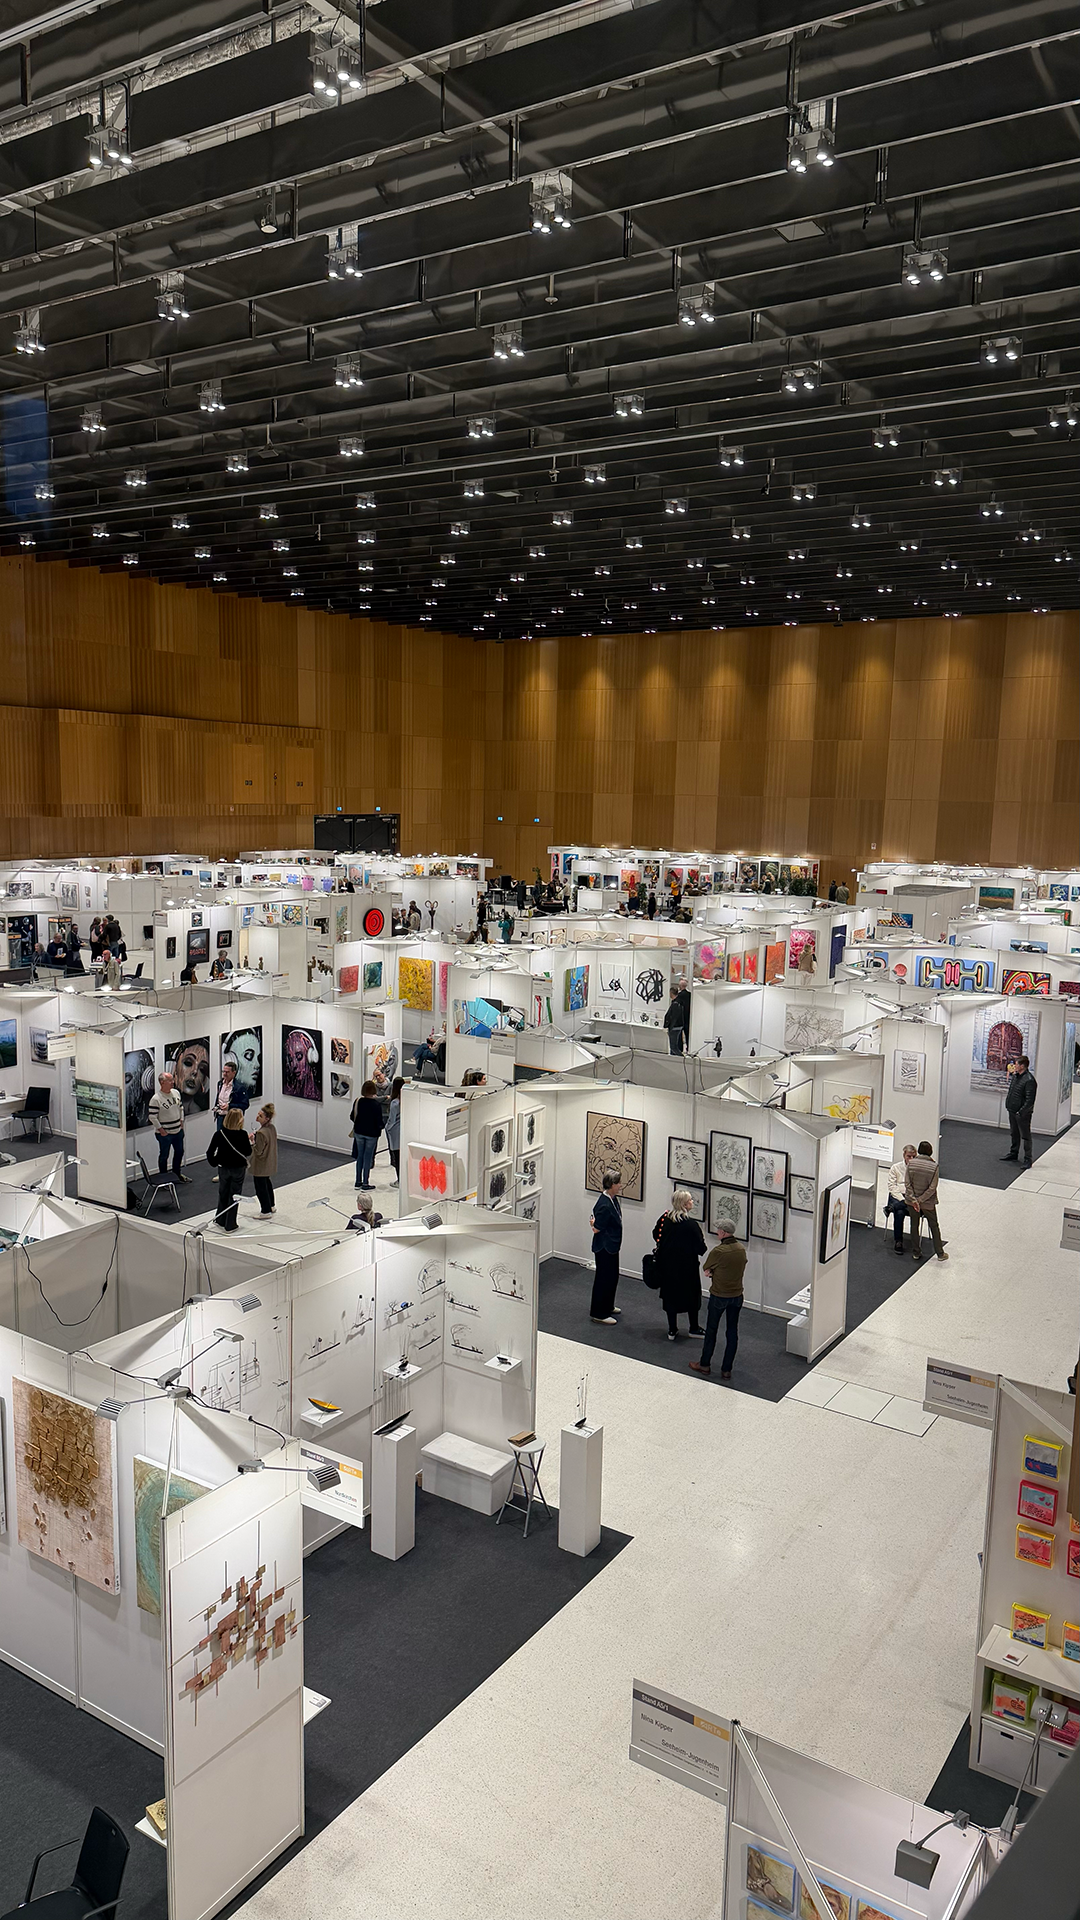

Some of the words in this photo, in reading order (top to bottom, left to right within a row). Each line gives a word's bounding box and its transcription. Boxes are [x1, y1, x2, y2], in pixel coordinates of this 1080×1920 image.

[641, 1694, 656, 1706] Stand
[640, 1712, 654, 1725] Nina
[655, 1719, 674, 1733] Kipper
[661, 1738, 720, 1772] Seeheim-Jugenheim
